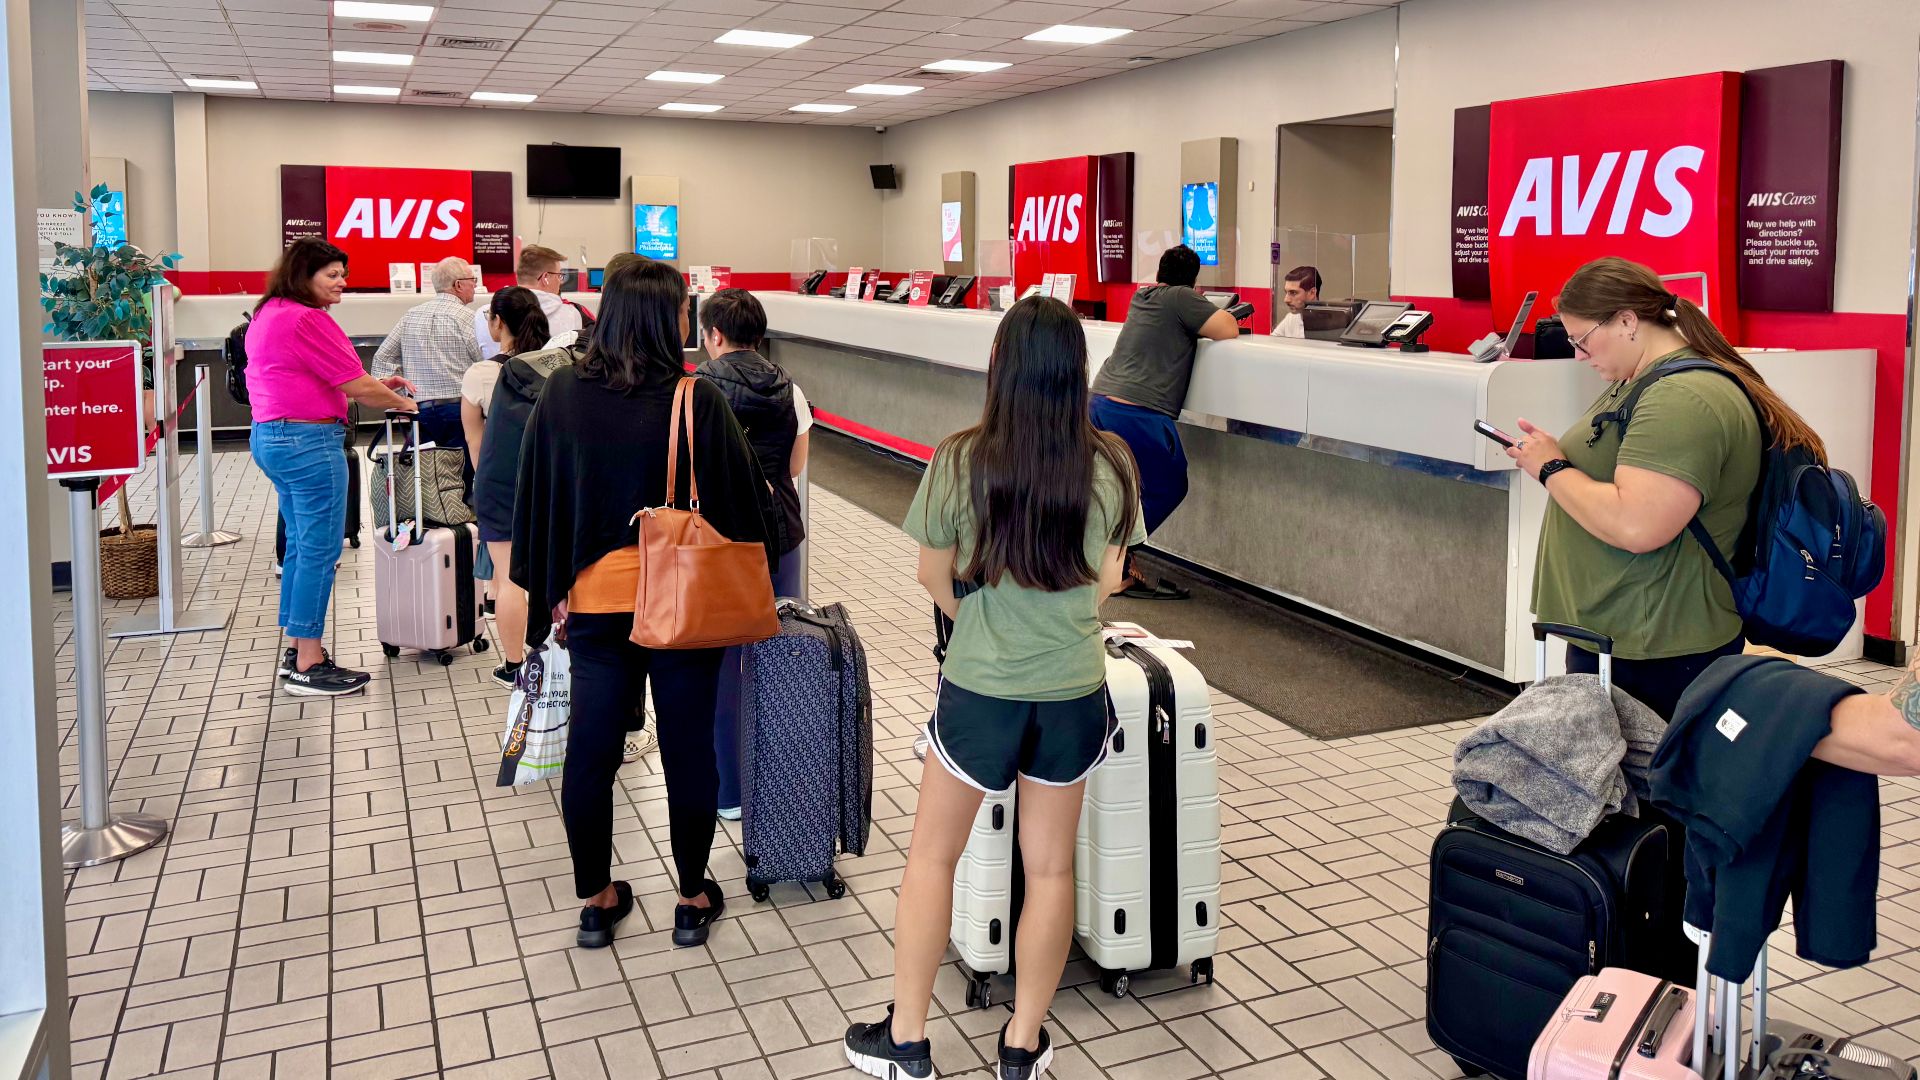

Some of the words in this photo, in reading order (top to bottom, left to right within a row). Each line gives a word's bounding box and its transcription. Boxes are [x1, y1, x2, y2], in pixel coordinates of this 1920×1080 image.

[1498, 145, 1705, 238] AVIS
[335, 198, 465, 241] AVIS
[1017, 193, 1083, 244] AVIS
[1746, 220, 1763, 229] May
[1779, 219, 1797, 228] help
[1799, 219, 1816, 227] with
[1759, 229, 1803, 237] directions?
[1745, 239, 1772, 247] Please
[1775, 238, 1802, 246] buckle
[1804, 239, 1818, 247] up,
[1743, 249, 1768, 257] adjust
[1769, 249, 1788, 259] your
[1789, 248, 1820, 256] mirrors
[1748, 257, 1764, 265] and
[1766, 256, 1786, 265] drive
[1788, 257, 1814, 267] safely.
[43, 359, 71, 371] tart
[75, 360, 112, 373] your
[44, 405, 77, 416] nter
[82, 402, 123, 414] here.
[290, 671, 310, 683] HOKA
